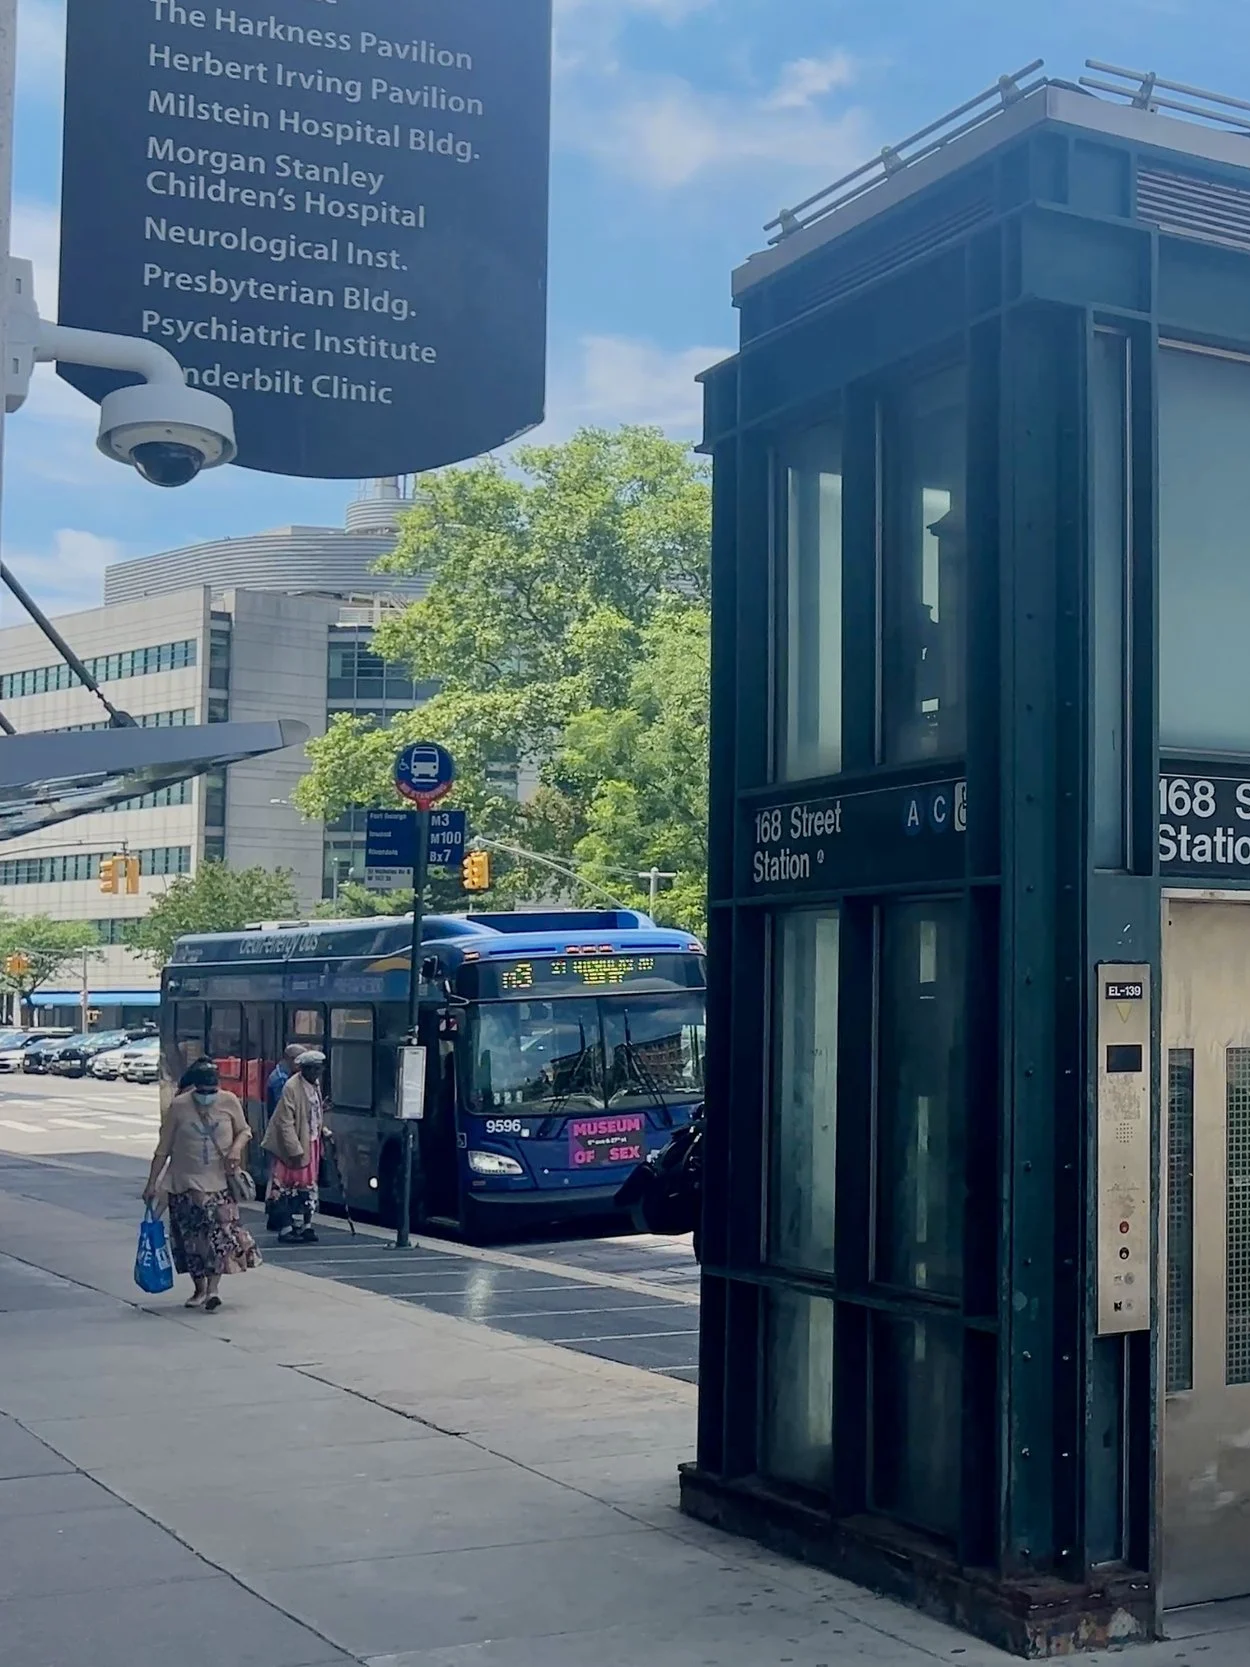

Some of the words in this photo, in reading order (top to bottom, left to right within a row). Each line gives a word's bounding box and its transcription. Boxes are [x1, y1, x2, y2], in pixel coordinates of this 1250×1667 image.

[150, 0, 207, 28] The
[215, 7, 351, 52] Harkness
[361, 31, 473, 71] Pavilion
[149, 44, 268, 84] Herbert
[276, 63, 362, 103] Irving
[371, 78, 483, 116] Pavilion
[148, 90, 269, 129] Milstein
[279, 109, 400, 151] Hospital
[409, 128, 480, 163] Bldg.
[147, 136, 266, 175] Morgan
[275, 154, 385, 196] Stanley
[146, 170, 296, 211] Children’s
[305, 191, 425, 228] Hospital
[144, 216, 338, 262] Neurological
[347, 241, 408, 271] Inst.
[143, 263, 334, 307] Presbyterian
[343, 286, 417, 321] Bldg.
[142, 310, 306, 350] Psychiatric
[314, 329, 437, 364] Institute
[184, 363, 304, 396] nderbilt
[311, 375, 393, 405] Clinic
[907, 800, 920, 827] A
[933, 795, 946, 823] C
[1160, 778, 1216, 818] 168
[430, 832, 462, 844] M100
[431, 813, 450, 826] M3
[755, 812, 782, 844] 168
[790, 801, 842, 839] Street
[429, 849, 452, 862] Bx7
[754, 848, 810, 883] Station
[1108, 986, 1142, 996] EL-139
[486, 1118, 522, 1134] 9596
[574, 1118, 640, 1136] MUSEUM
[574, 1150, 594, 1164] OF
[610, 1146, 640, 1160] SEX
